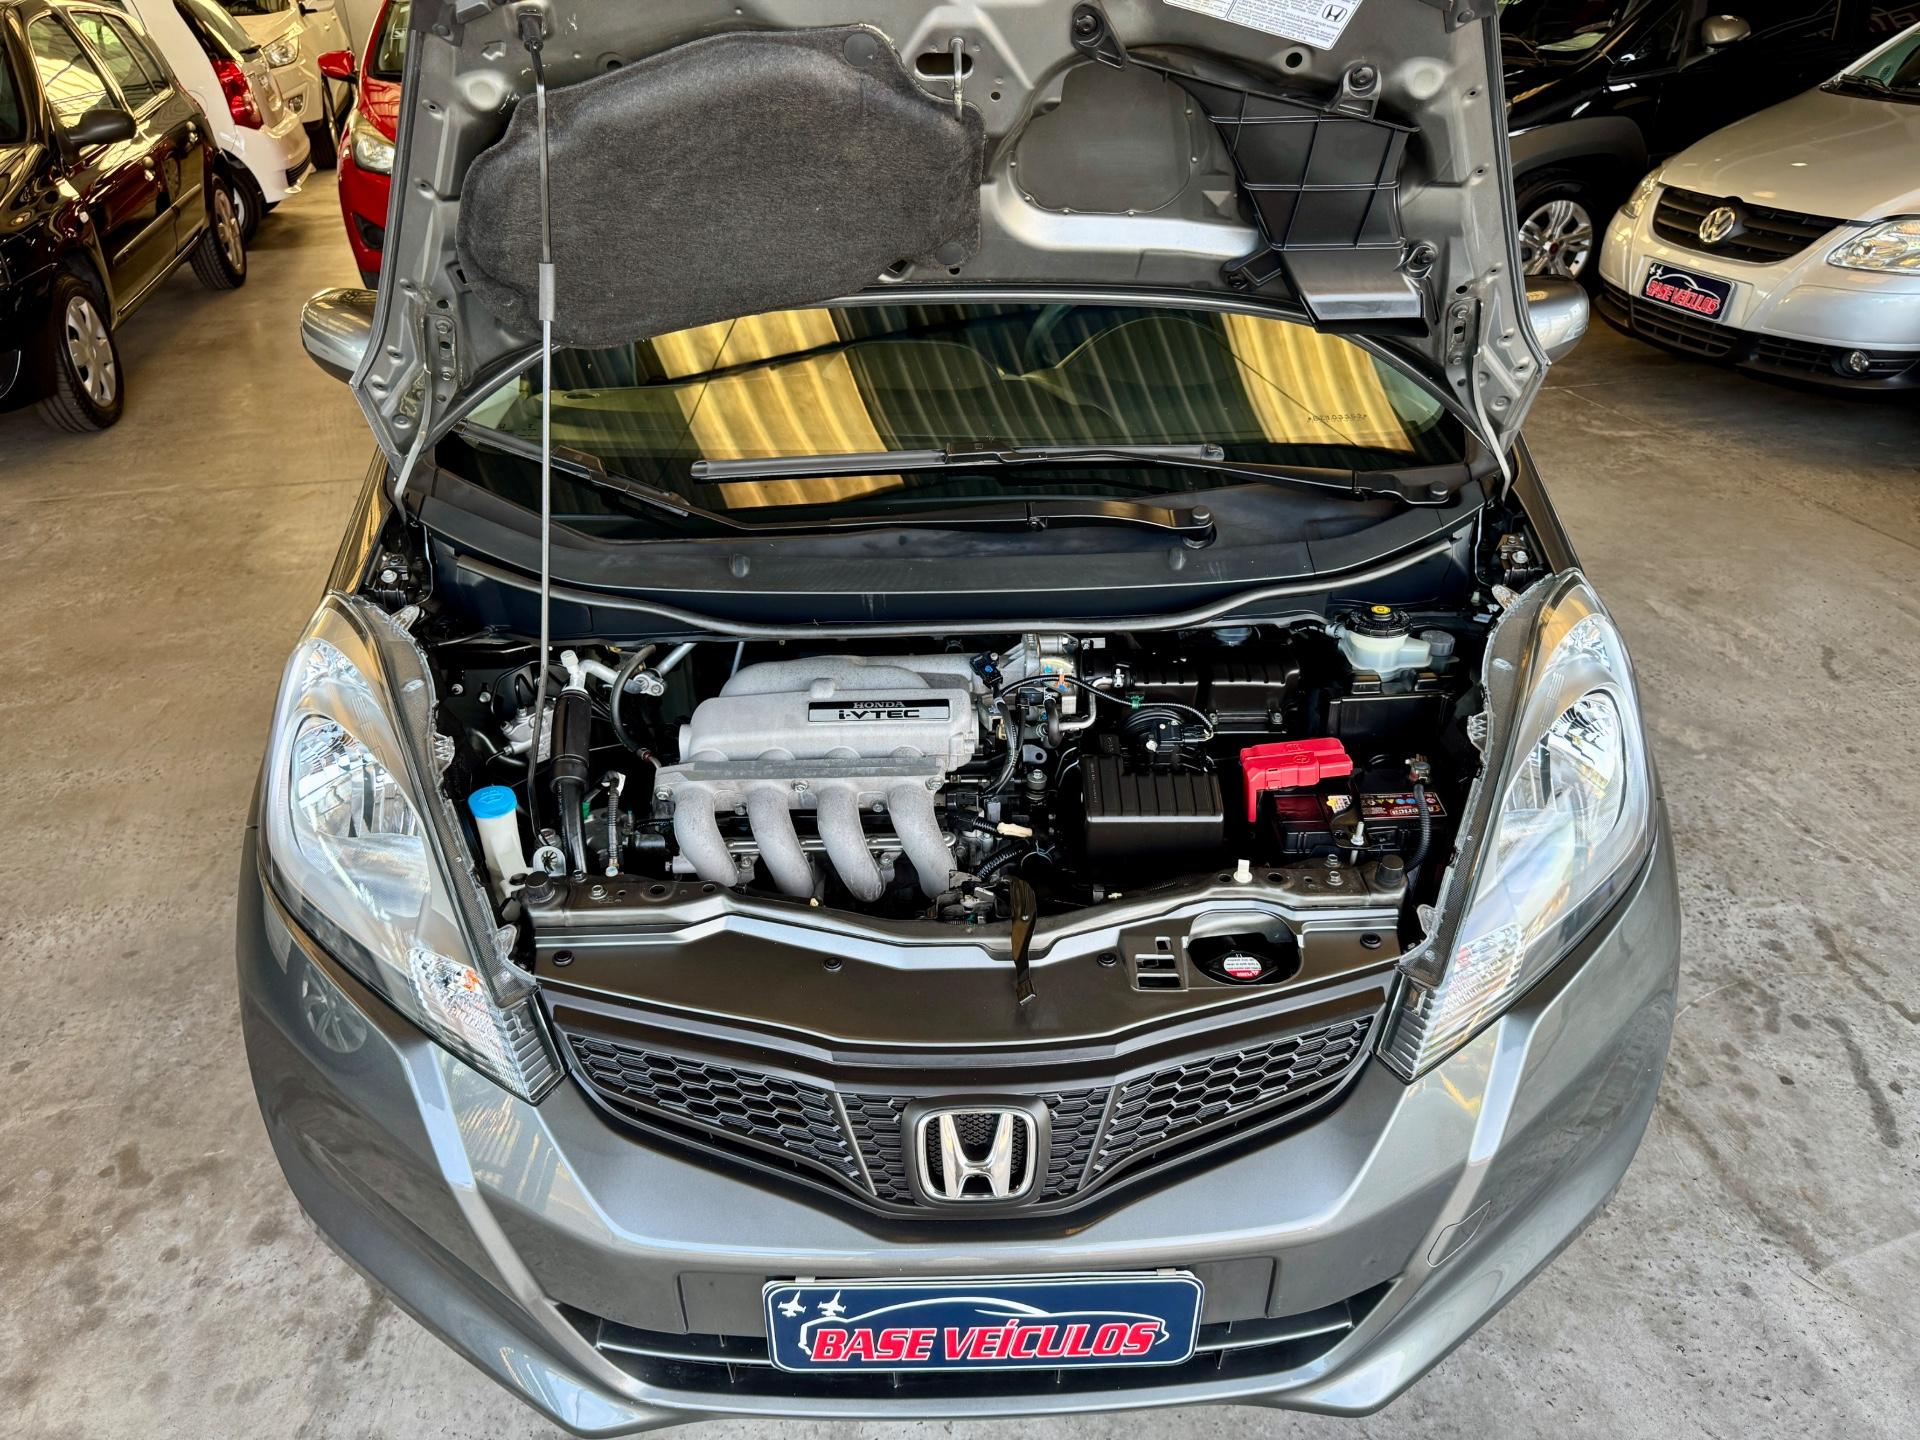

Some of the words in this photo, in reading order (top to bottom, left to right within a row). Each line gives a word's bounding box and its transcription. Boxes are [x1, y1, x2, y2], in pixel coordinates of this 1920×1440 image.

[1646, 280, 1675, 301] BASE
[853, 701, 906, 709] HONDA
[838, 709, 920, 720] i-VTEC
[810, 1328, 935, 1361] BASE
[944, 1319, 1161, 1360] VEÍCULOS
